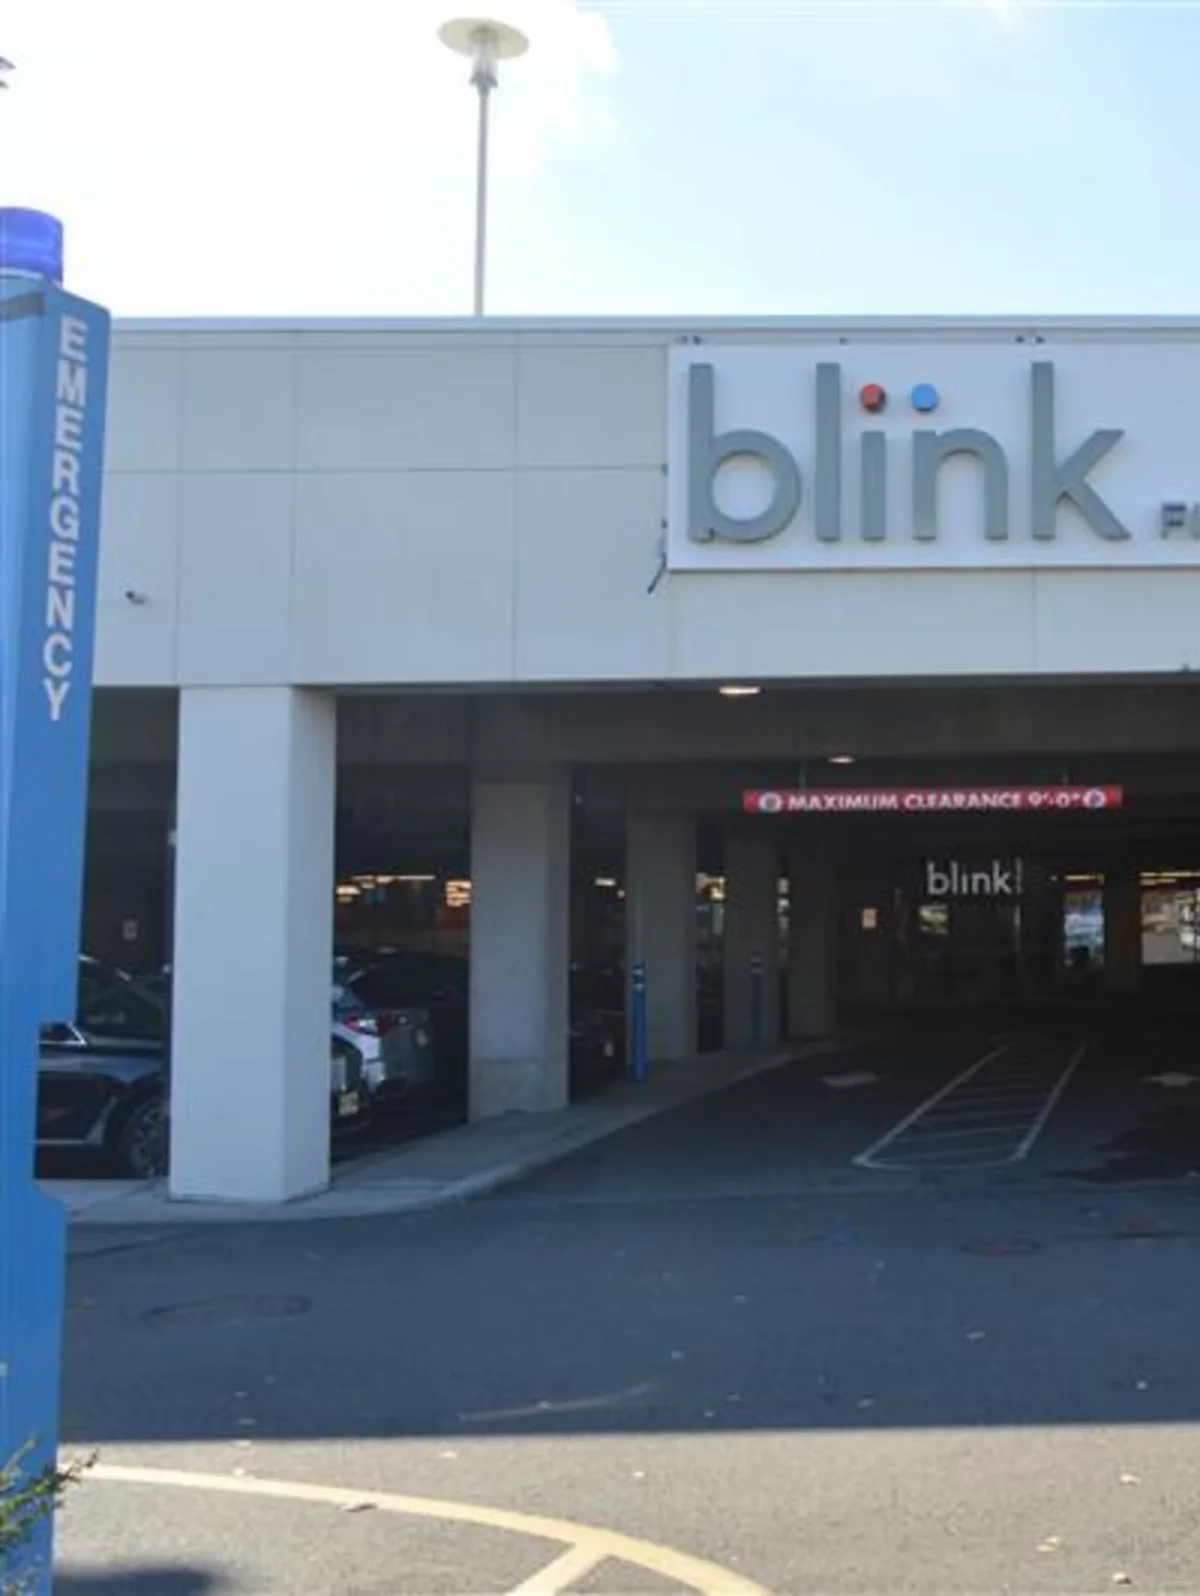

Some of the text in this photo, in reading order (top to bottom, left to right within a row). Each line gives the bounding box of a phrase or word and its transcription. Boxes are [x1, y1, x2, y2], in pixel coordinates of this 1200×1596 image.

[687, 361, 1131, 543] blink
[43, 316, 88, 722] EMERGENCY
[787, 793, 898, 811] MAXIMUM
[903, 791, 1021, 810] CLEARANCE
[927, 859, 1012, 895] blink
